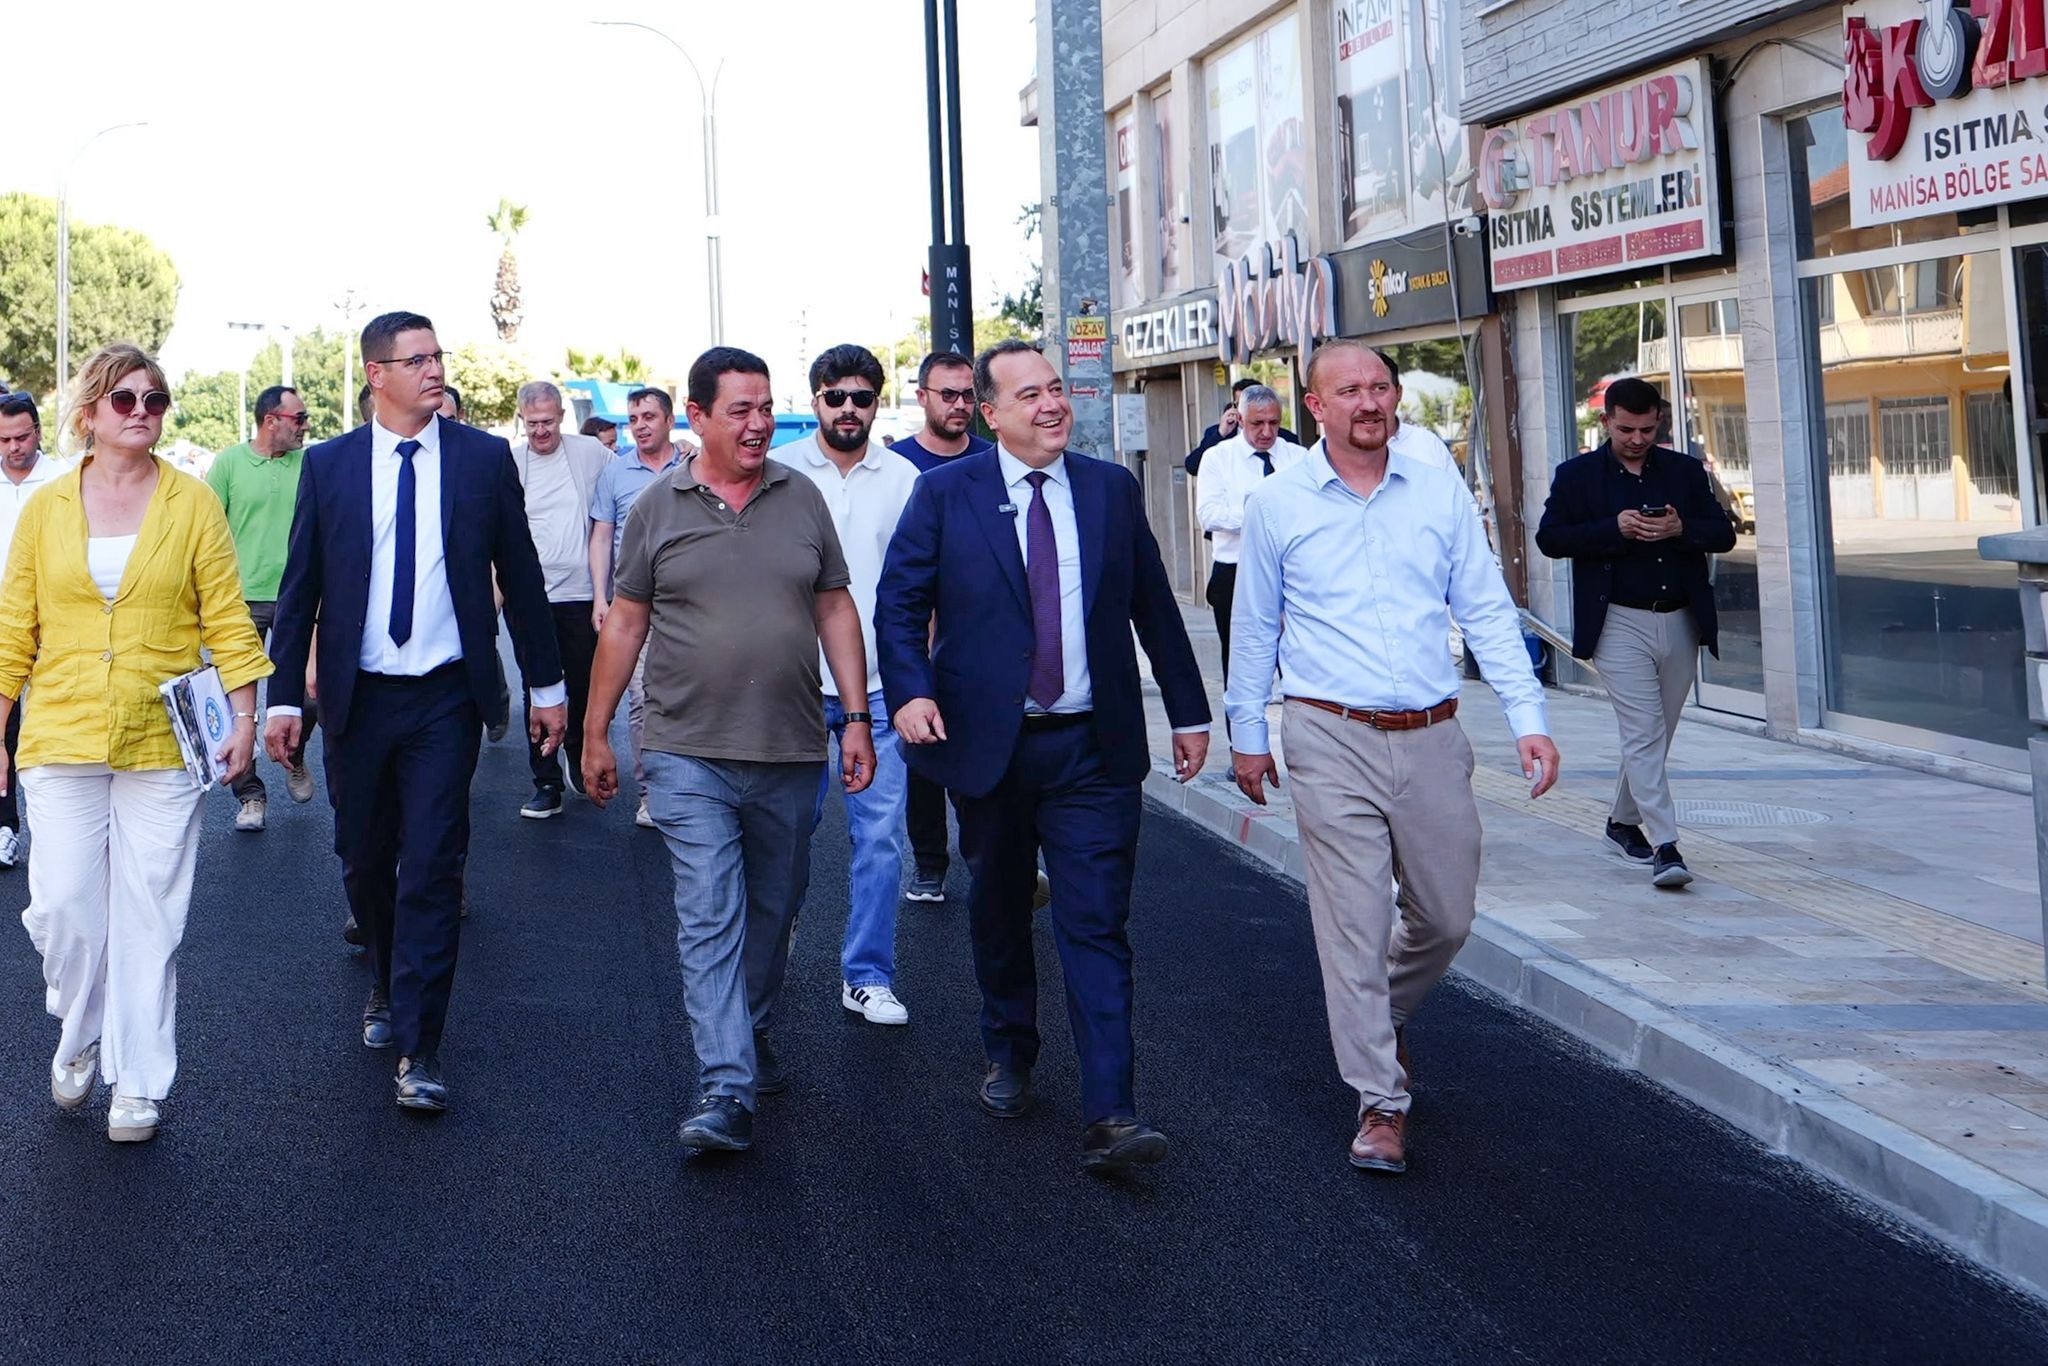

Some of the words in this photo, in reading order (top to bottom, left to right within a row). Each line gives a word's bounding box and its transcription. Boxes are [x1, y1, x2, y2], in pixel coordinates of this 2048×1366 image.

[1525, 75, 1697, 187] TANUR
[1924, 110, 2033, 162] ISITMA
[1945, 163, 2011, 201] BÖLGE
[1492, 204, 1554, 250] ISITMA
[1122, 299, 1214, 359] GEZEKLER
